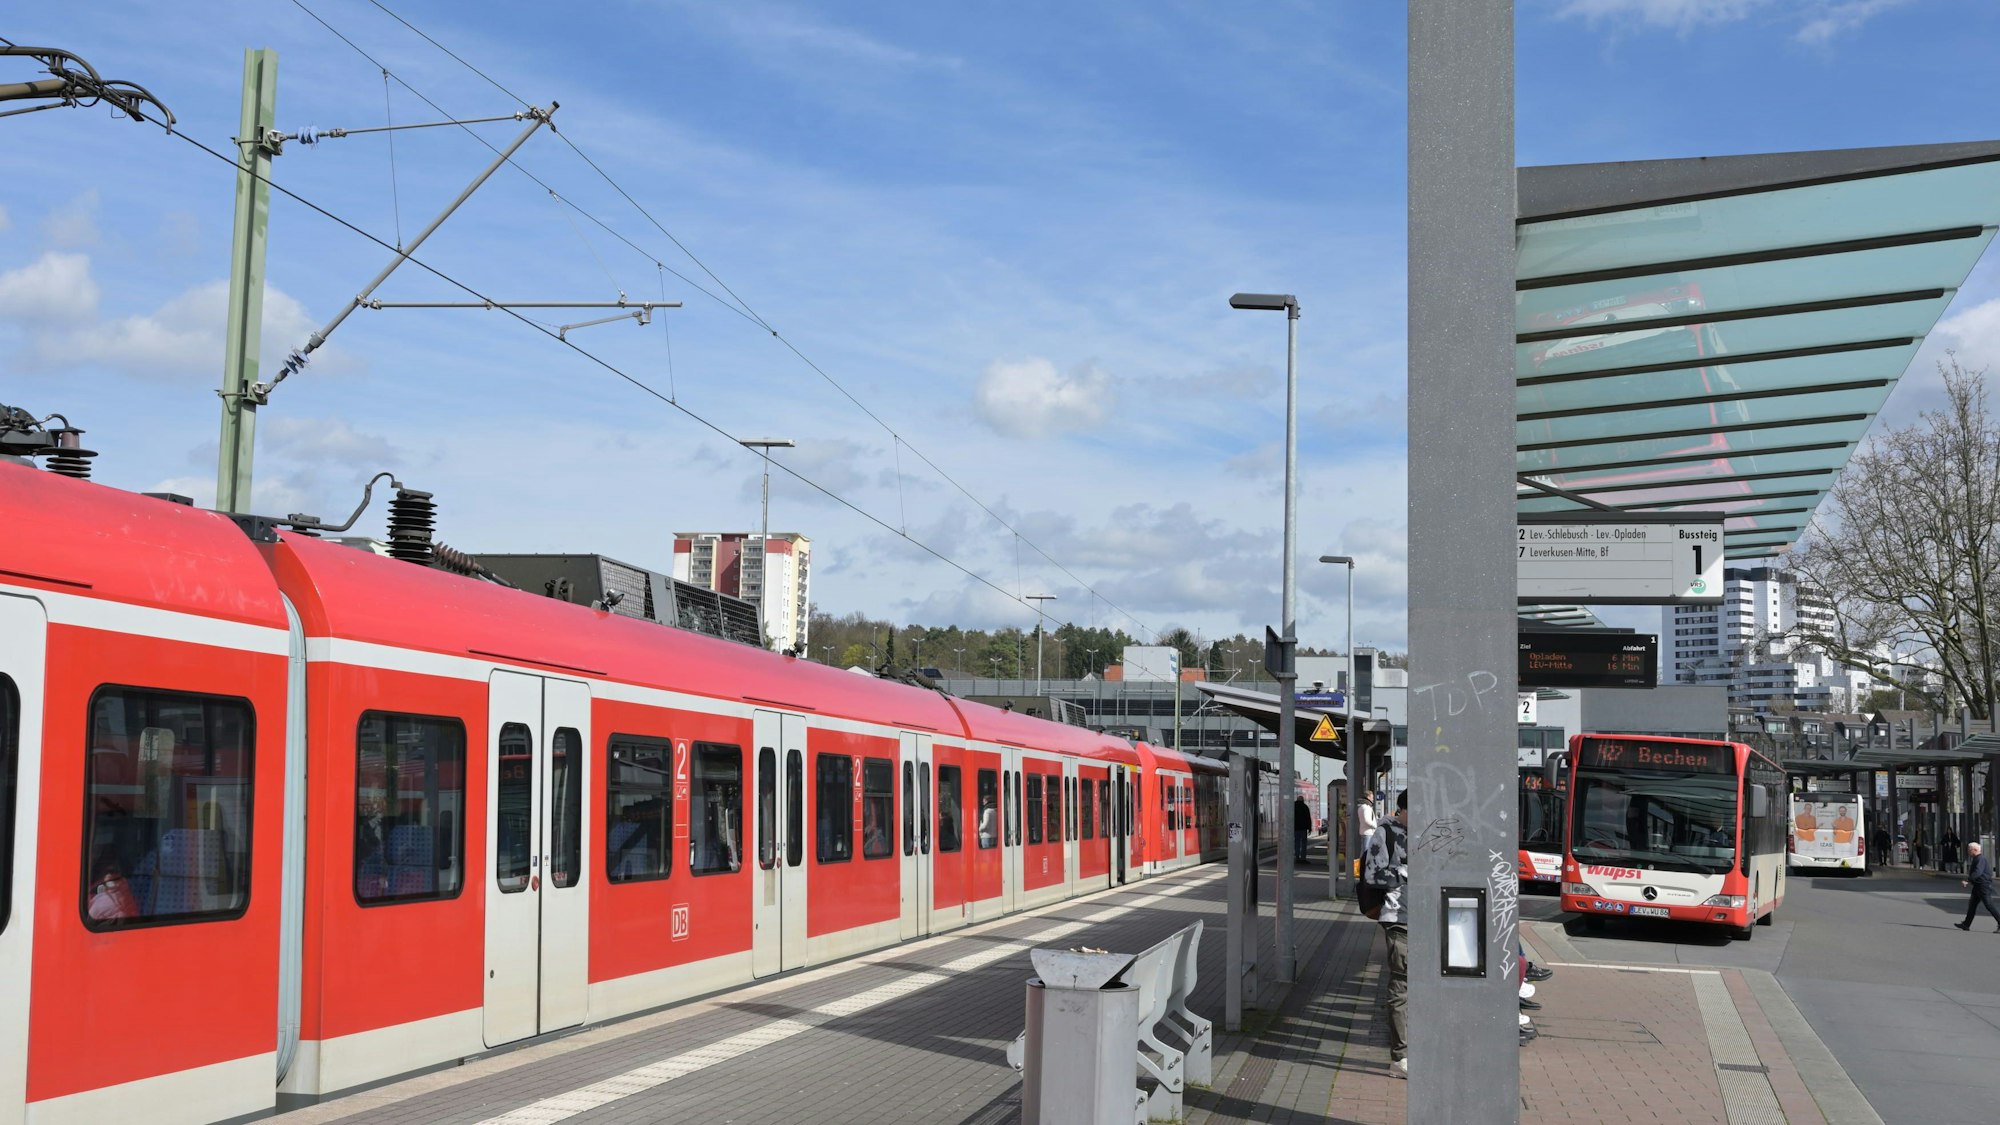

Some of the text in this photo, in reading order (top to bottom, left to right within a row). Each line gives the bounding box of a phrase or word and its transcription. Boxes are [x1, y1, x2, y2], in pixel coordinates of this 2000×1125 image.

[1530, 528, 1588, 539] Lev.-Schlebusch
[1596, 528, 1646, 541] Lev.-Opladen
[1679, 529, 1718, 542] Bussteig
[1530, 547, 1598, 558] Leverkusen-Mitte,
[1600, 546, 1609, 557] Bf
[1692, 545, 1702, 575] 1
[1651, 636, 1656, 644] 1
[1530, 653, 1566, 661] Opladen
[1530, 661, 1640, 670] LEV-Mitte 16 Min
[1523, 701, 1530, 714] 2
[677, 743, 686, 780] 2
[1638, 746, 1707, 766] Bechen
[855, 758, 861, 787] 2
[673, 909, 687, 936] DB
